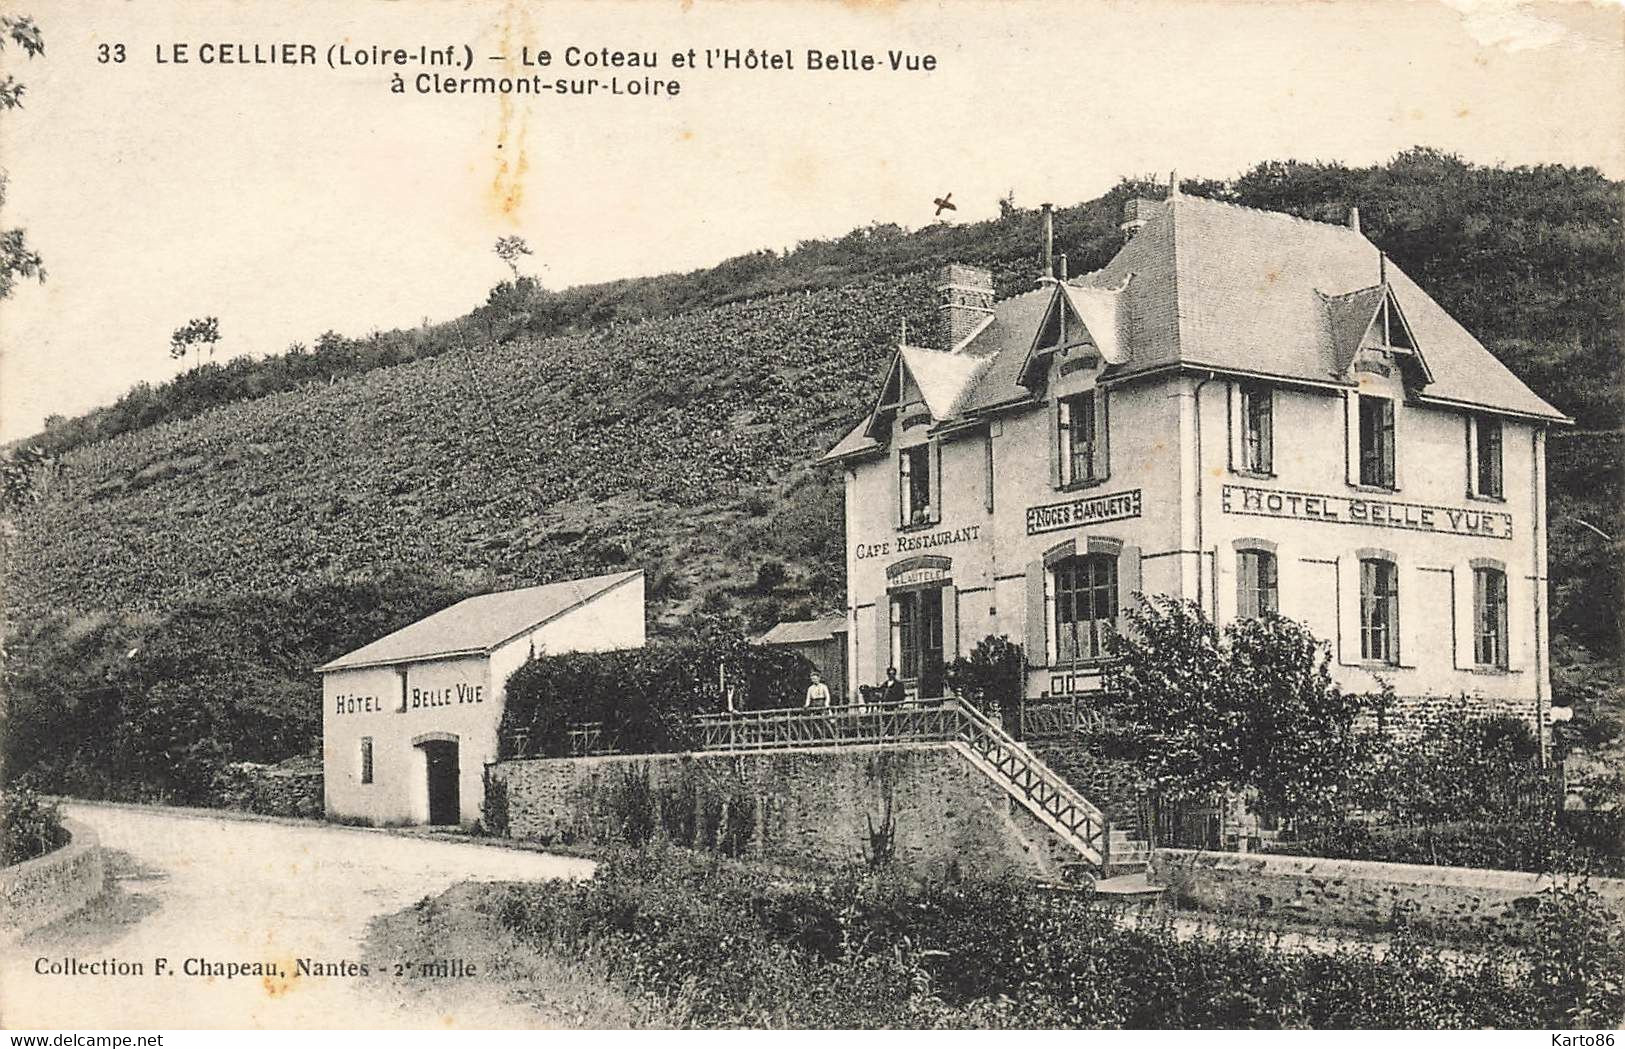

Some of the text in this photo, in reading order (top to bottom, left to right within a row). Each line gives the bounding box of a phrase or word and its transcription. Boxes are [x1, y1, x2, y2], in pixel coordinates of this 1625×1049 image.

[1035, 497, 1131, 527] NOCES BANQUETS
[1349, 499, 1435, 526] BELLE
[1447, 511, 1495, 533] VUE
[896, 526, 980, 552] RESTAURANT
[412, 688, 451, 708] BELLE
[456, 683, 483, 703] VUE
